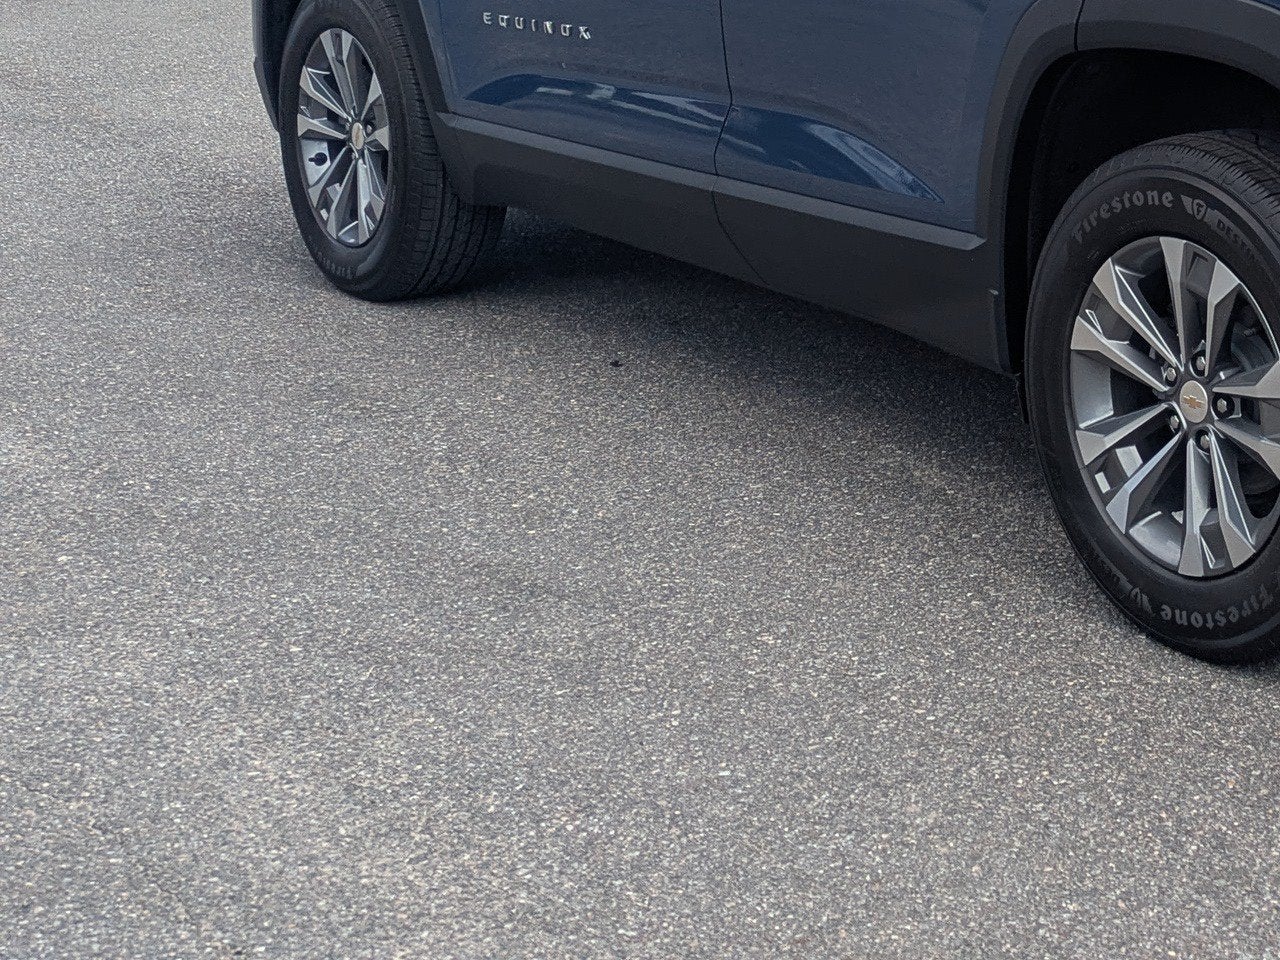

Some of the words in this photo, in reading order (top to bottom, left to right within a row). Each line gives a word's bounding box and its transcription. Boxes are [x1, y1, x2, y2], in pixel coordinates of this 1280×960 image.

[482, 12, 592, 40] EQUINOX
[1072, 189, 1174, 243] Firestone
[1160, 586, 1275, 630] Firestone
